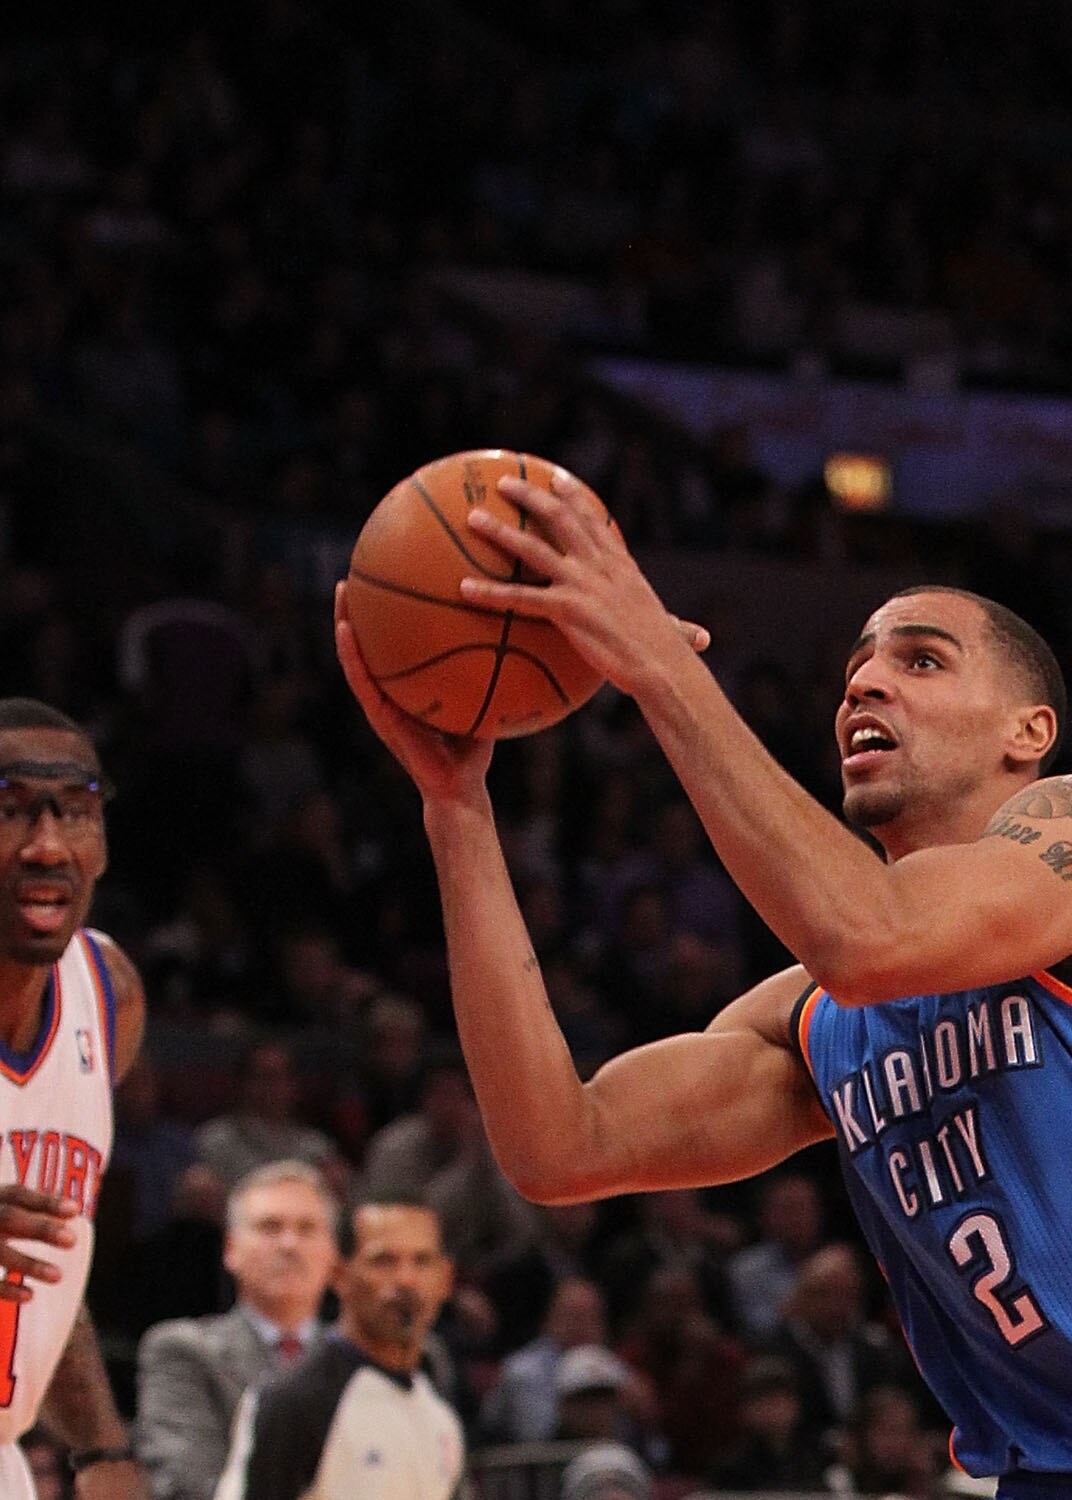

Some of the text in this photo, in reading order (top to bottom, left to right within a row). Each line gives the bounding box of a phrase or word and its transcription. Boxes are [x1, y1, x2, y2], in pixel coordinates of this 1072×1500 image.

[831, 994, 1037, 1153] KLAOMA
[888, 1107, 986, 1217] CITY
[948, 1212, 1045, 1346] 2
